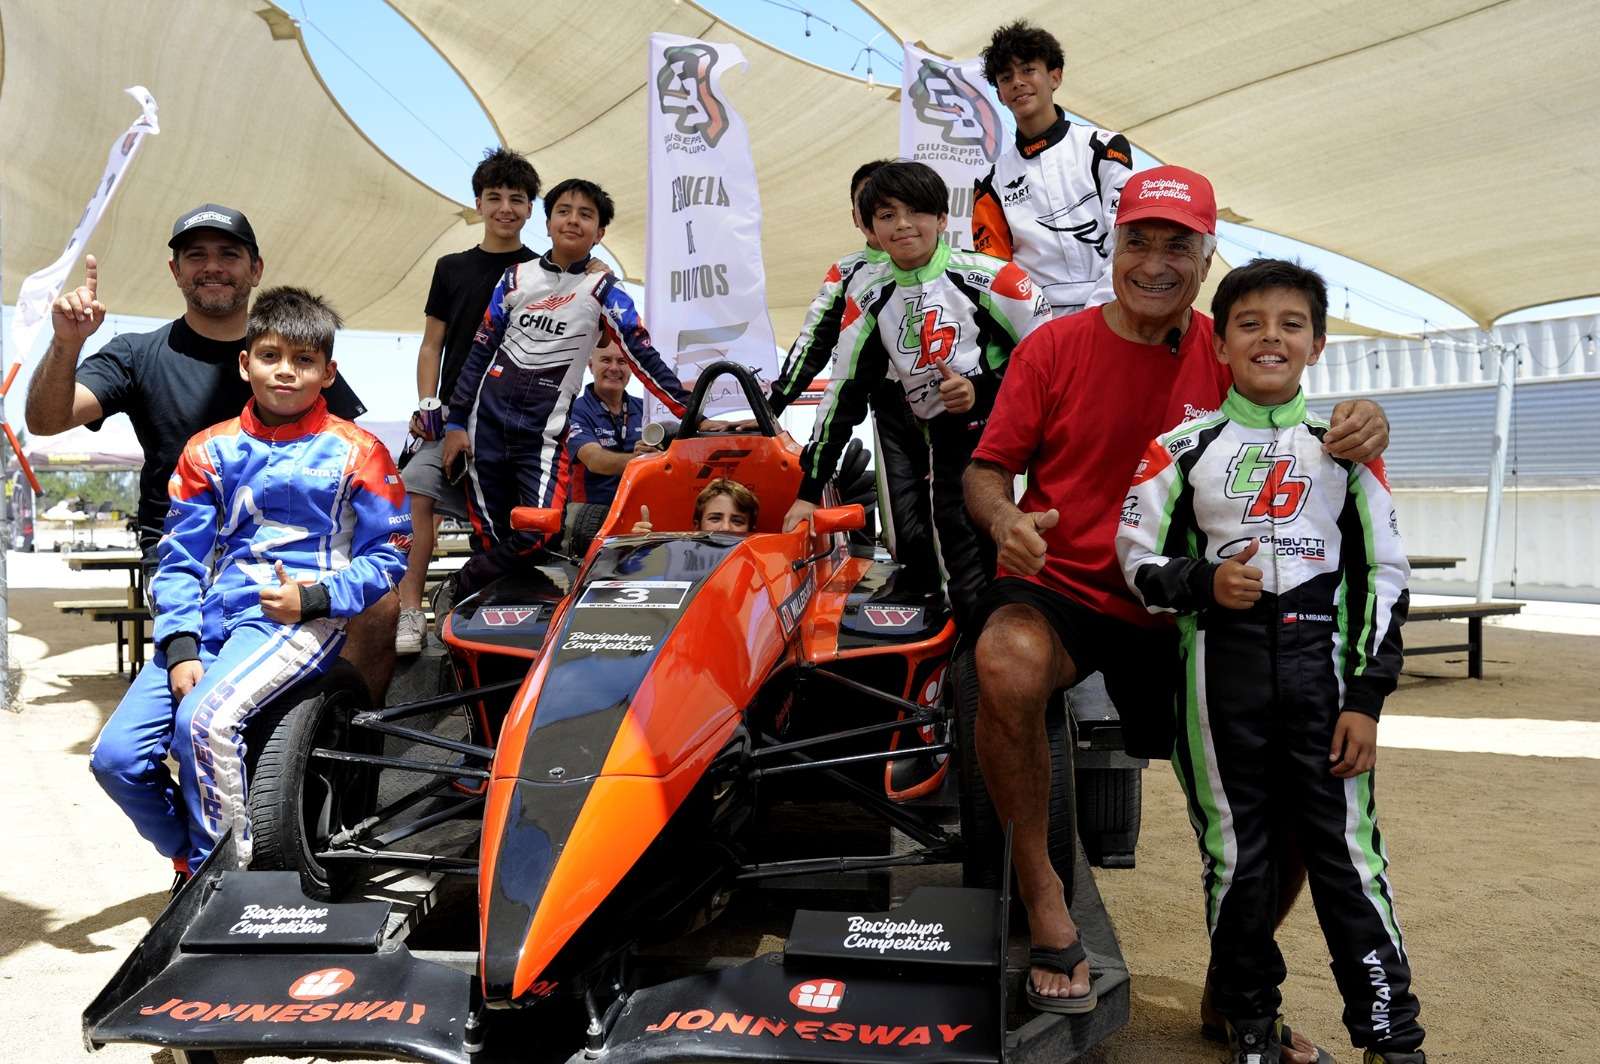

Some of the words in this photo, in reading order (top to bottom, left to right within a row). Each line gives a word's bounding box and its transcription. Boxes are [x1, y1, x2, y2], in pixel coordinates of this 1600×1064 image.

[916, 143, 982, 156] GIUSEPPE
[913, 153, 985, 166] BACIGALUPO
[1141, 178, 1189, 191] Bacigalupo
[1004, 184, 1030, 202] KART
[968, 273, 990, 285] OMP
[1018, 278, 1032, 293] OM
[860, 290, 875, 308] OMP
[519, 314, 567, 336] CHILE
[1169, 438, 1192, 454] OMP
[1276, 547, 1325, 557] CORSE
[613, 588, 650, 603] 3
[1299, 614, 1333, 622] B.MIRANDA
[569, 631, 652, 643] Bacigalupo
[562, 640, 655, 652] Competición
[240, 904, 329, 923] Bacigalupo
[848, 916, 944, 939] Bacigalupo
[843, 933, 951, 954] Competición
[645, 1009, 973, 1046] JONNESWAY
